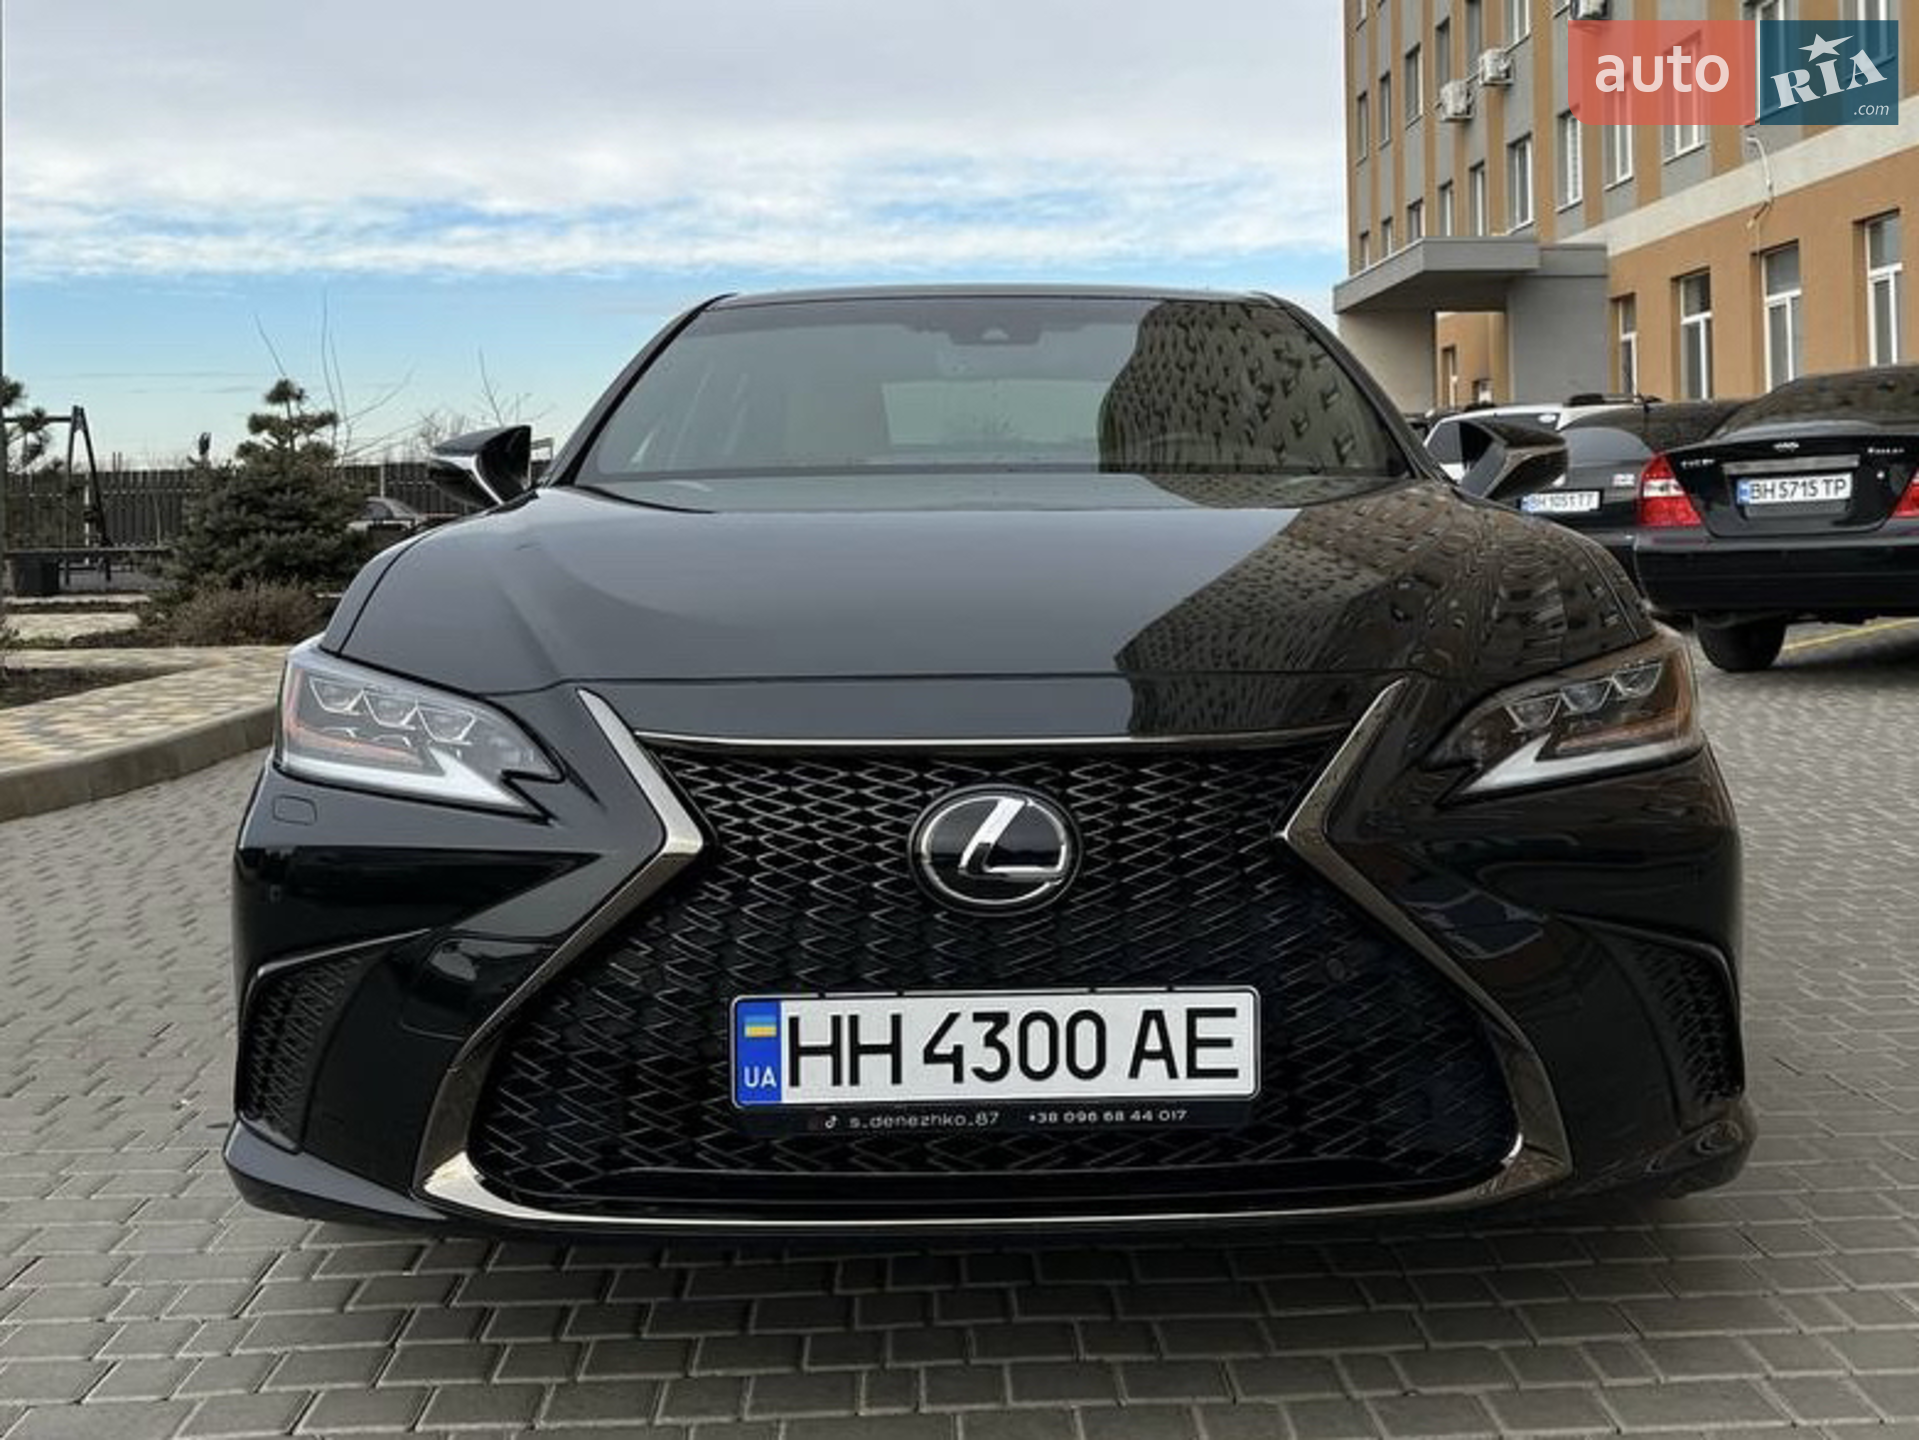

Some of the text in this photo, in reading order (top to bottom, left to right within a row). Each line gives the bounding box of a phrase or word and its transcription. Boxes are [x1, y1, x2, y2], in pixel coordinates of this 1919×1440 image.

[1750, 479, 1847, 500] BH 5715 TP
[787, 1006, 1240, 1087] HH 4300 AE
[743, 1066, 778, 1089] UA
[1130, 1110, 1154, 1122] 44
